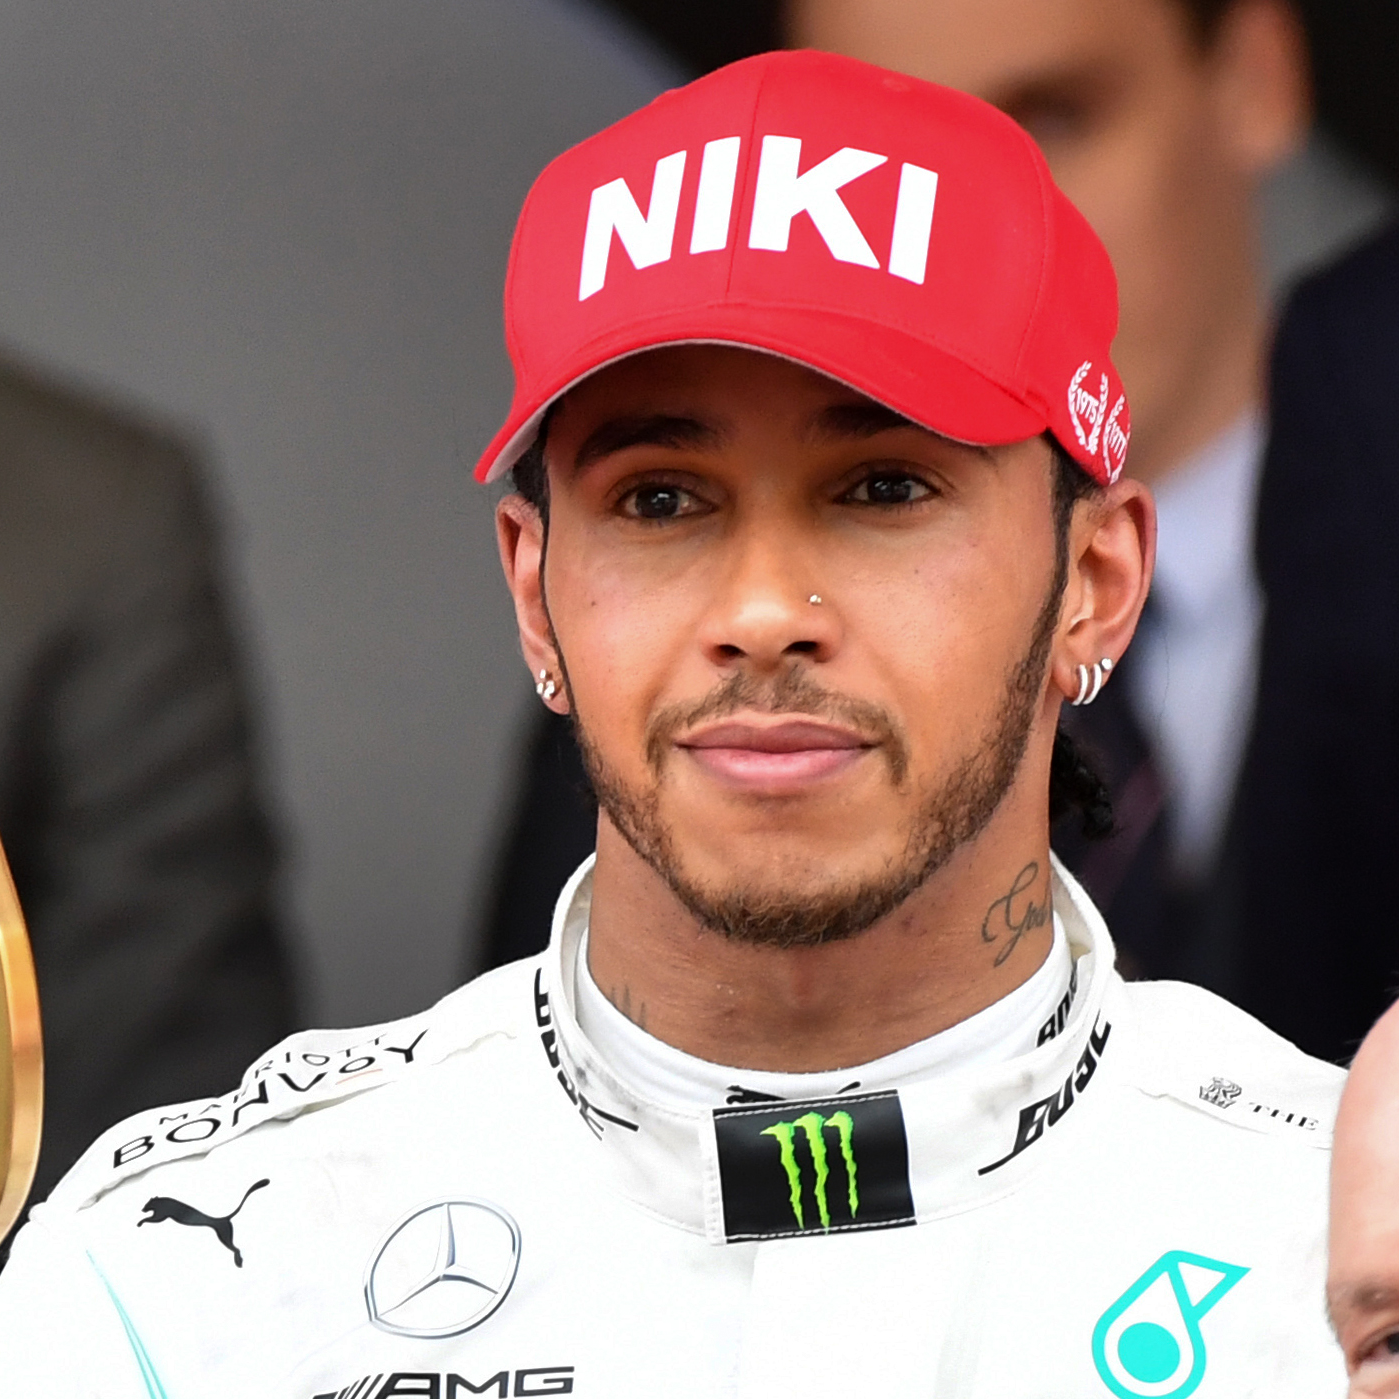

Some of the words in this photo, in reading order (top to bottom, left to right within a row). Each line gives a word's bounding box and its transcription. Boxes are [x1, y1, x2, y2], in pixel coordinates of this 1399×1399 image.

[580, 136, 938, 301] NIKI
[1076, 387, 1100, 424] 1975
[113, 1029, 428, 1168] BONVOY
[1249, 1102, 1319, 1131] THE
